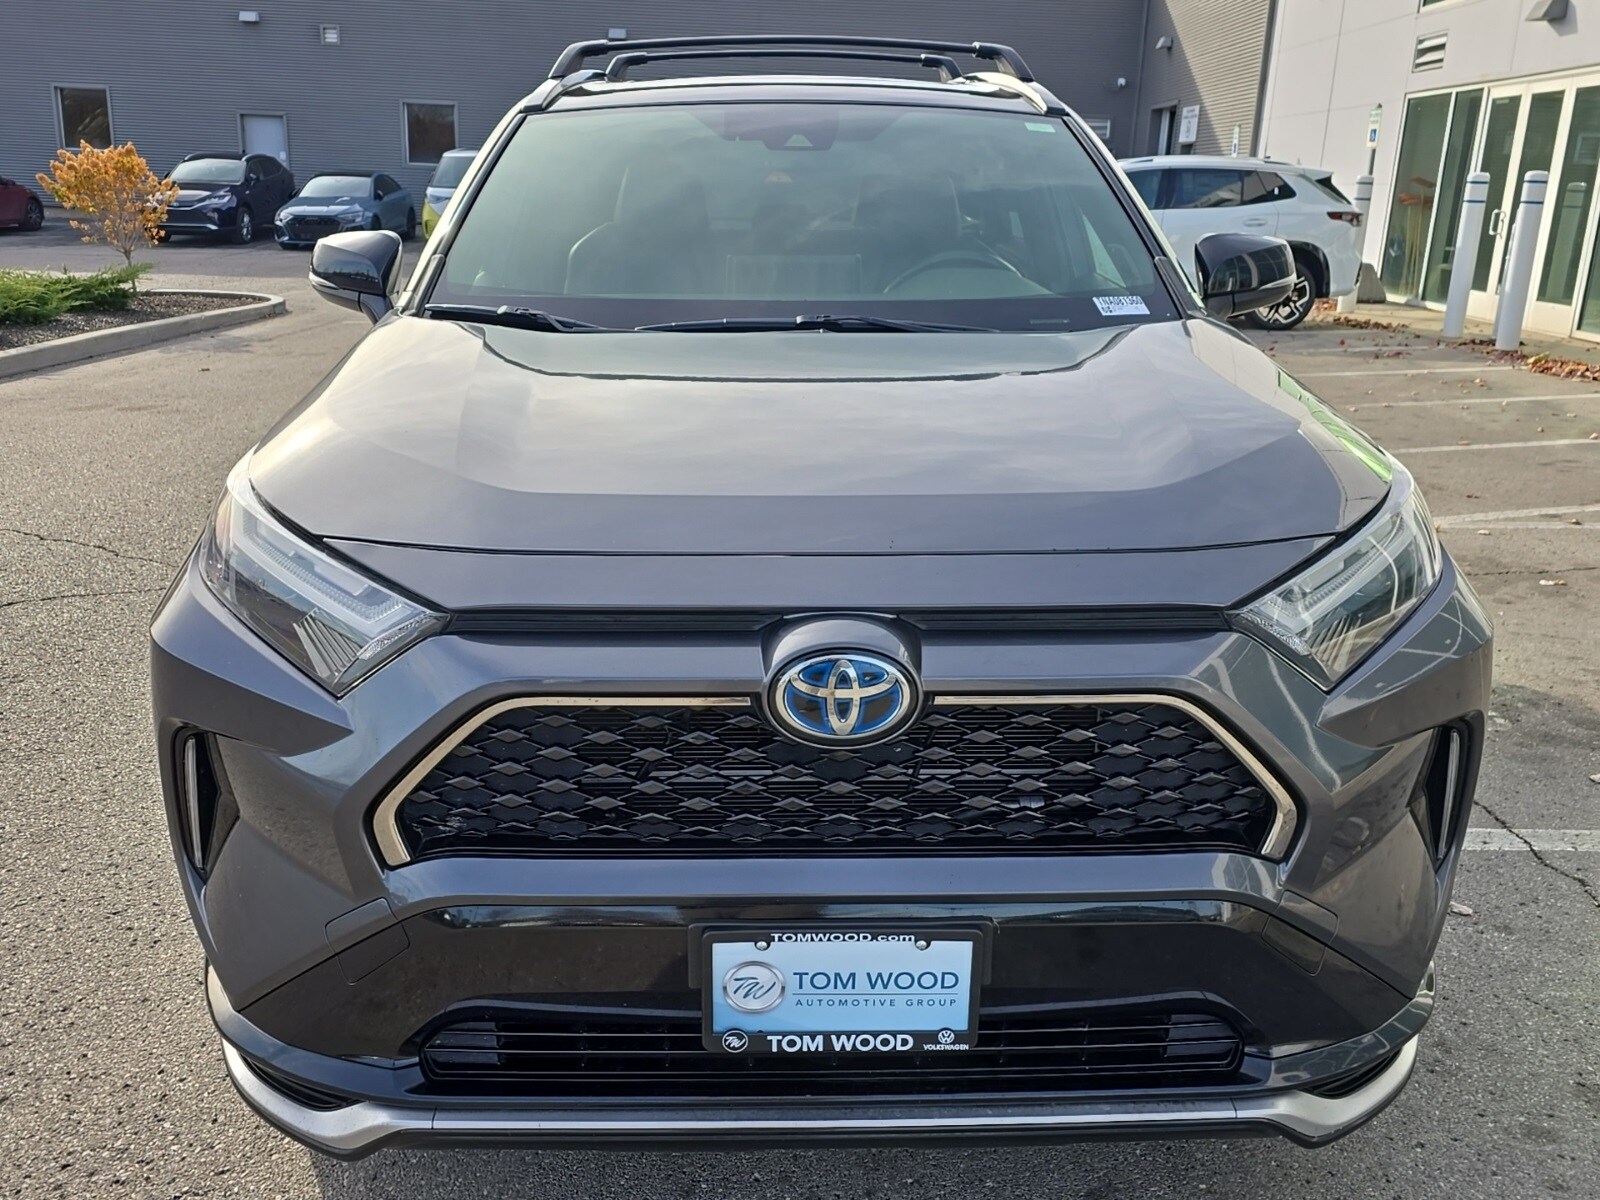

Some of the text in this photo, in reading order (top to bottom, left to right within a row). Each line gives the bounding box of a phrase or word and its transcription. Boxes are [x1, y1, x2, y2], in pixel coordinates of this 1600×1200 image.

[770, 933, 915, 942] TOMWOOD.com
[793, 971, 959, 990] TOM WOOD
[795, 998, 957, 1007] AUTOMOTIVE GROUP
[767, 1034, 914, 1052] TOM WOOD
[923, 1043, 969, 1051] VOLKSWAGEN
